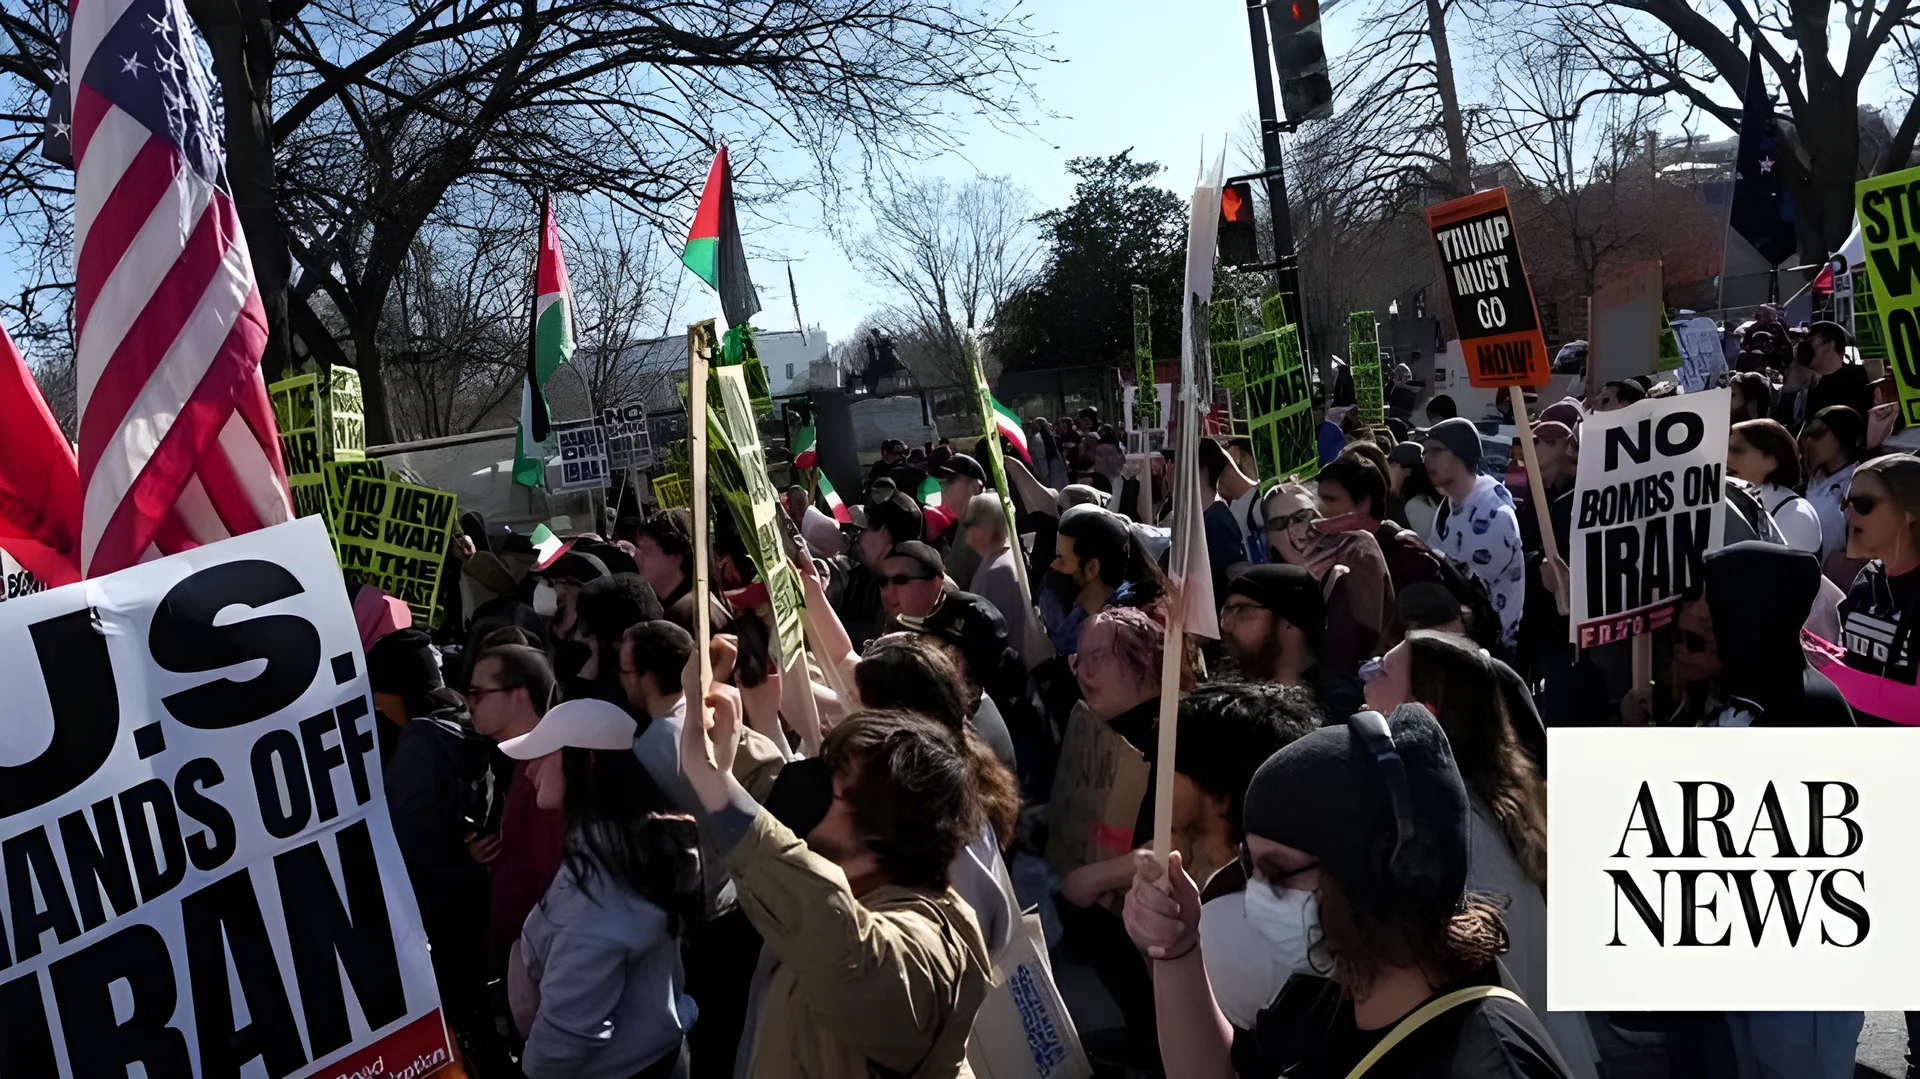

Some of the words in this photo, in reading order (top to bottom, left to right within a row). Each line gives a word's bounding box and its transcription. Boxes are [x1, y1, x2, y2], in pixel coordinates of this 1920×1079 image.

[1436, 215, 1510, 262] TRUMP
[1452, 255, 1510, 296] MUST
[1476, 296, 1507, 329] GO
[1476, 339, 1535, 377] NOW!
[1604, 411, 1704, 472] NO
[345, 477, 387, 515] NO
[391, 486, 455, 529] NEW
[1578, 471, 1675, 529] BOMBS
[1683, 463, 1722, 507] ON
[342, 512, 380, 541] US
[384, 519, 446, 555] WAR
[340, 543, 374, 568] IN
[376, 551, 440, 578] THE
[1585, 508, 1712, 620] IRAN
[0, 757, 237, 969] ANDS
[250, 694, 375, 840] OFF
